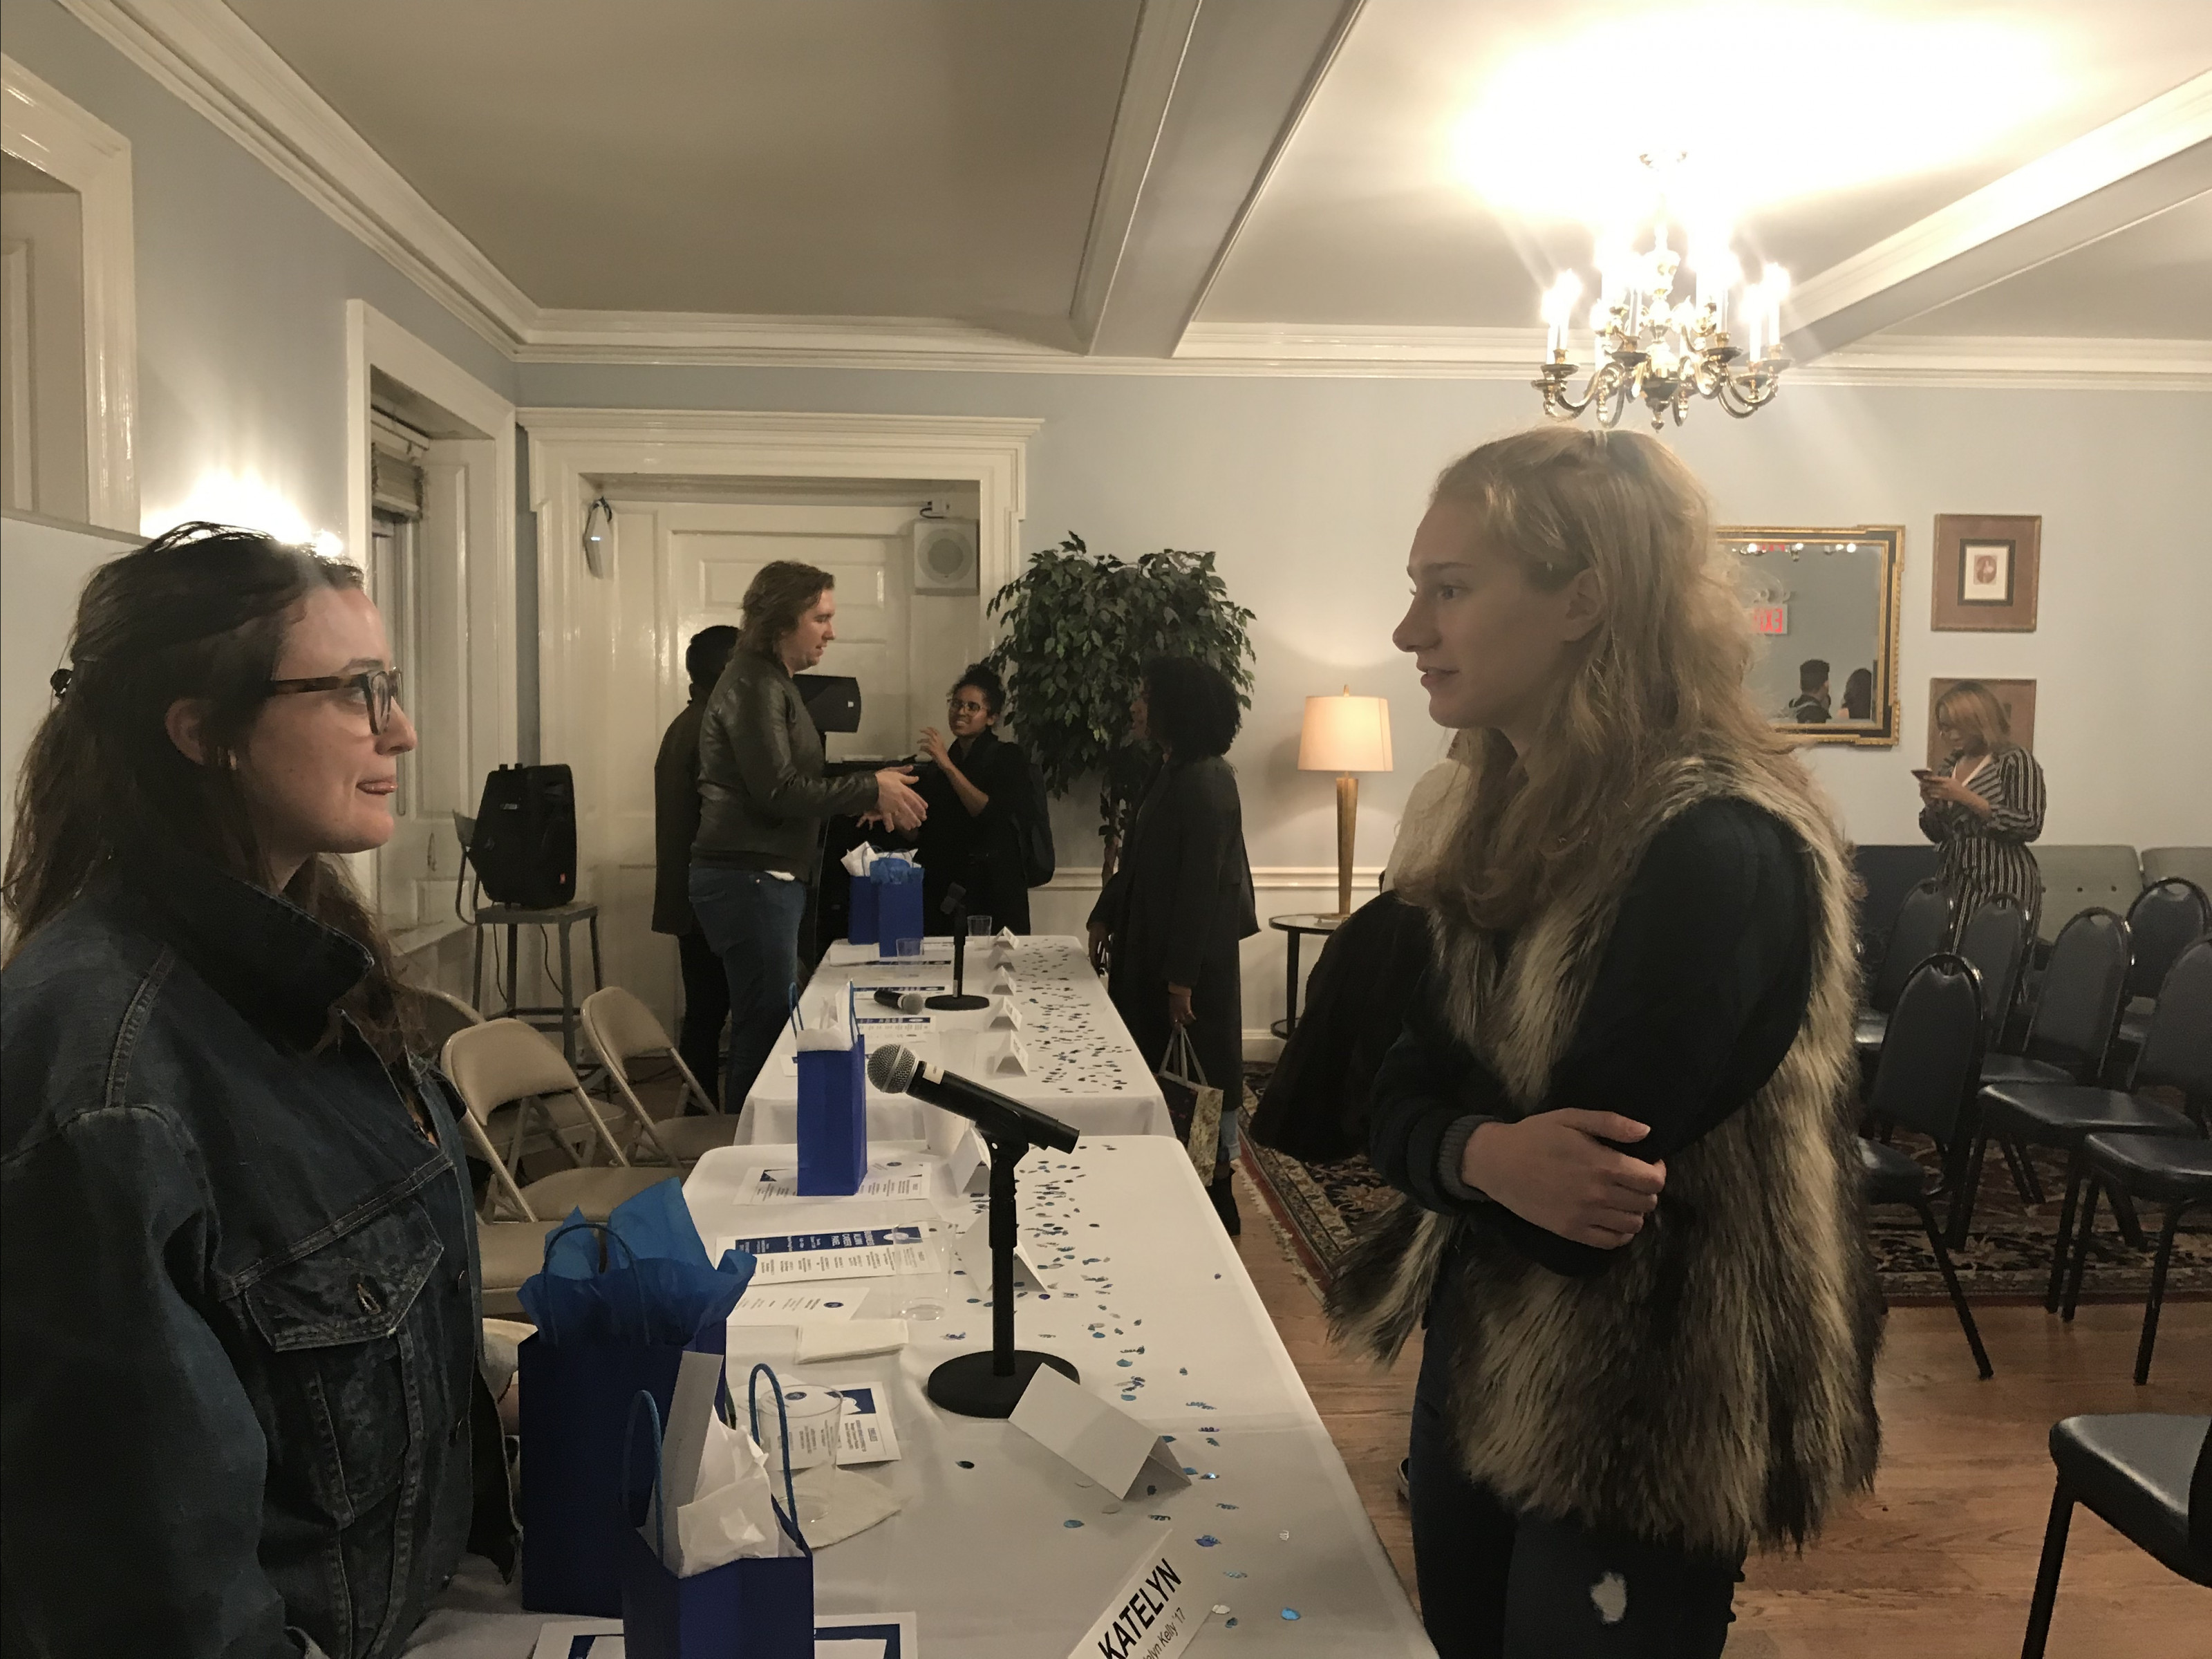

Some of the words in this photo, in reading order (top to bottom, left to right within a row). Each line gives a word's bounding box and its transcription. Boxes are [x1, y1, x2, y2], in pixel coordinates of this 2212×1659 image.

[1098, 1557, 1181, 1659] KATELYN
[1157, 1622, 1178, 1647] Kelly
[1172, 1607, 1185, 1624] '17
